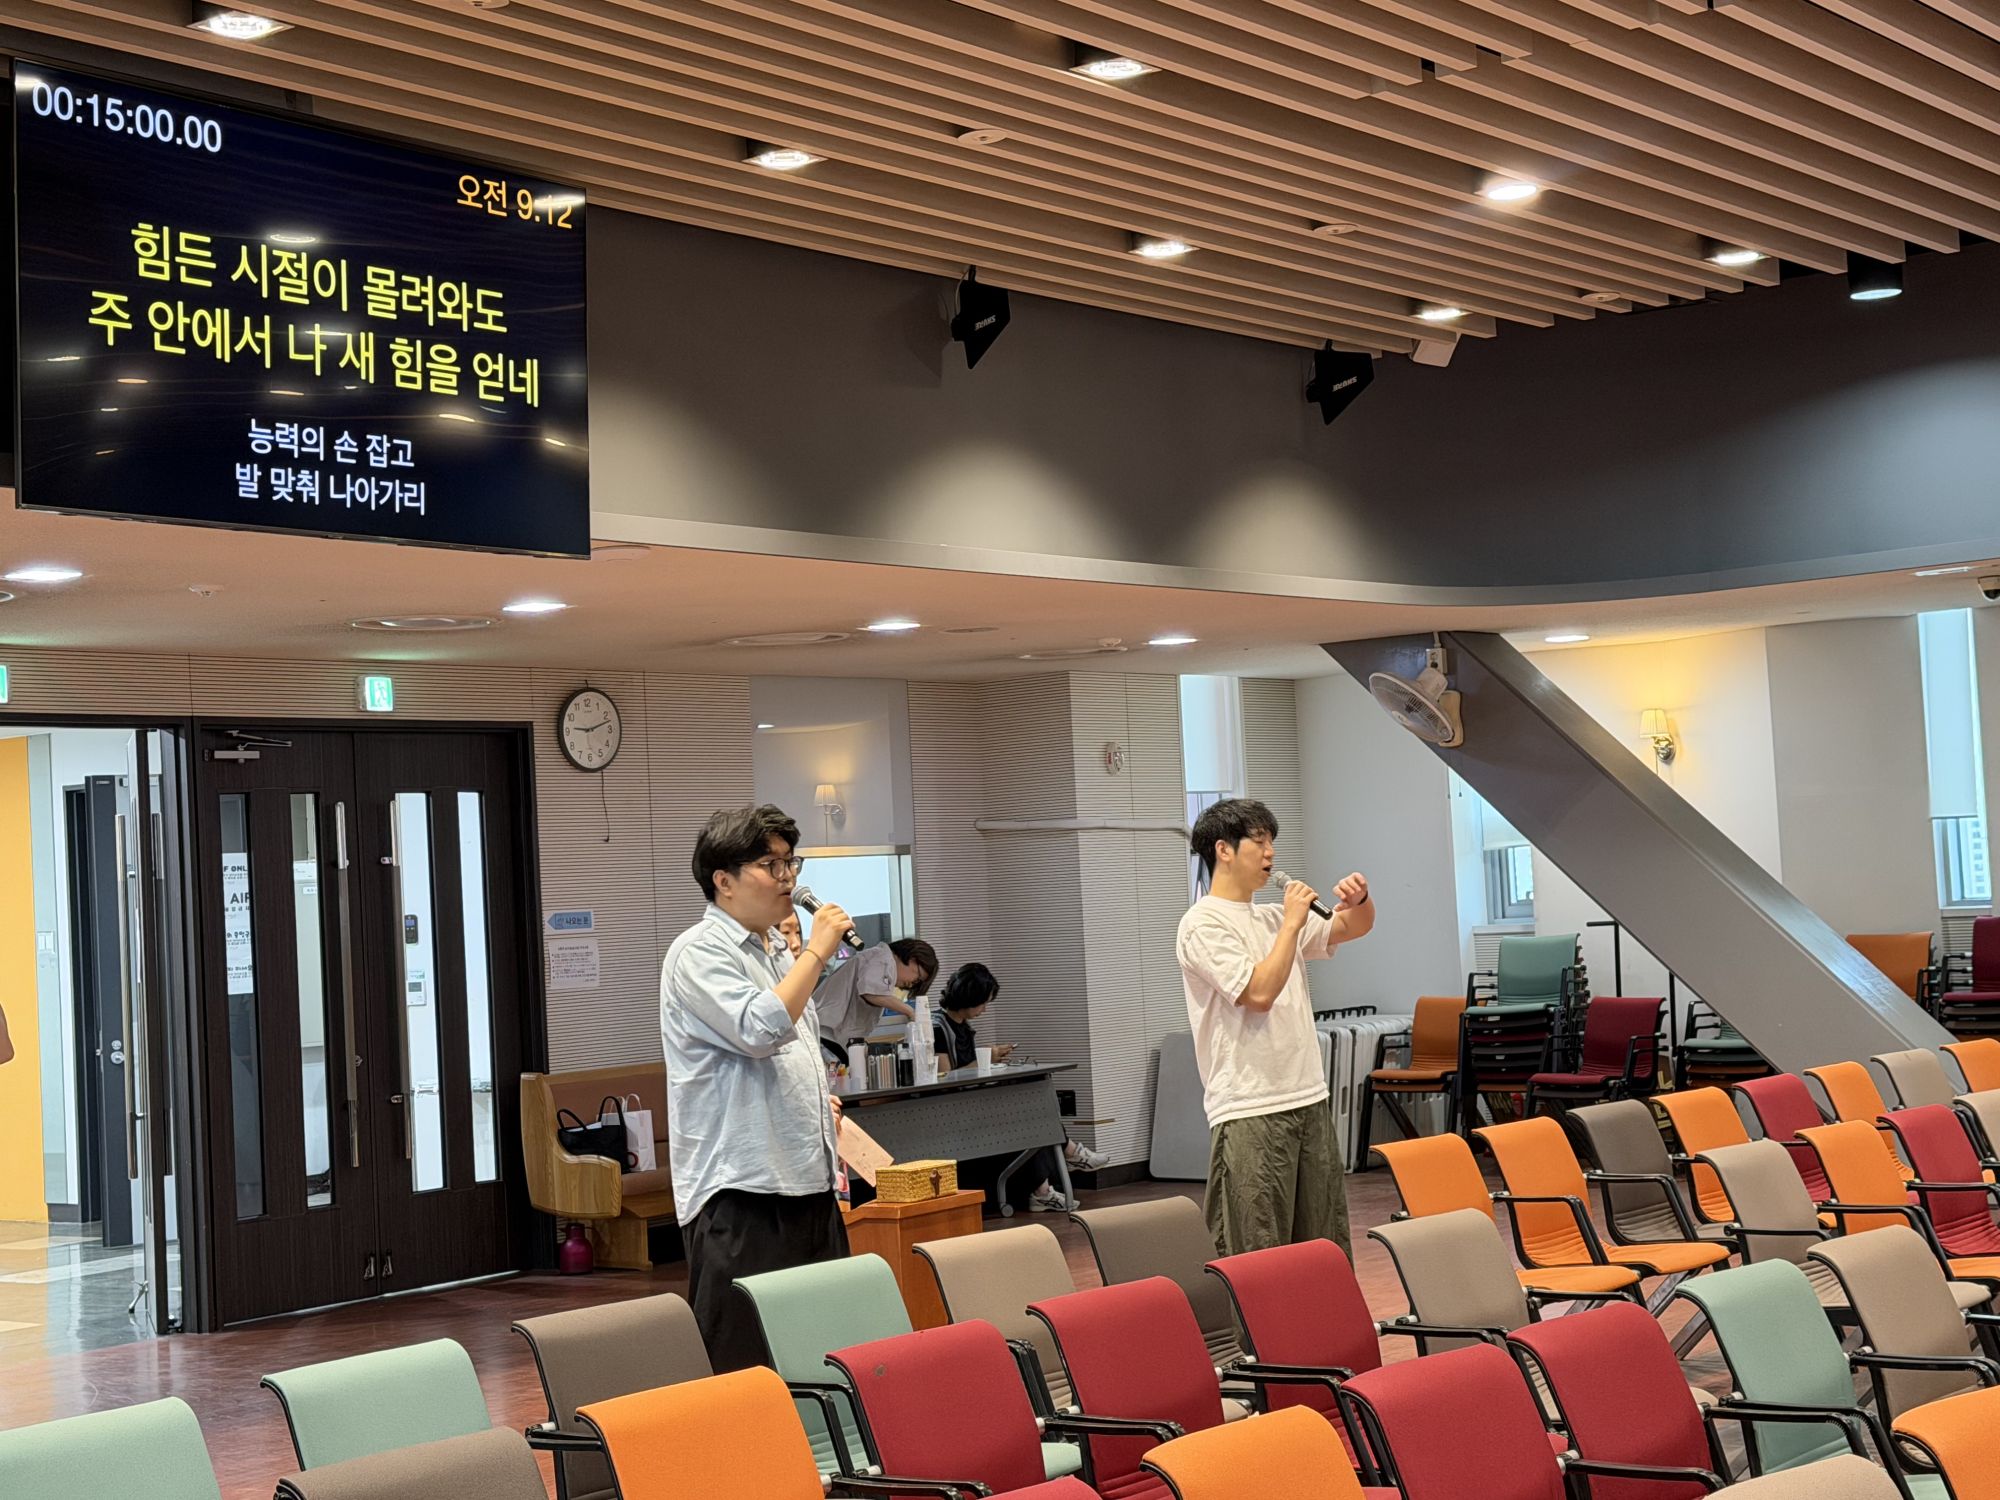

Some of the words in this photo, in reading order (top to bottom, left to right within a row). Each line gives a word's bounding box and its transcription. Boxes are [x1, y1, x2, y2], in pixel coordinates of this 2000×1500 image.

[32, 82, 222, 152] 00:15:00.00
[458, 175, 507, 216] 오전
[131, 222, 216, 288] 힘든
[230, 244, 348, 311] 시절이
[361, 266, 506, 335] 몰려와도
[89, 292, 132, 345] 주
[148, 302, 270, 367] 안에서
[288, 322, 326, 376] 나
[340, 333, 374, 383] 새
[390, 338, 460, 396] 힘을
[473, 353, 539, 407] 얻네
[248, 419, 324, 461] 능력의
[334, 431, 358, 463] 손
[366, 435, 414, 468] 잡고
[236, 463, 261, 498] 발
[271, 468, 319, 505] 맞춰
[330, 474, 424, 515] 나아가리
[574, 703, 580, 711] 11
[583, 698, 591, 707] 12
[596, 702, 599, 710] 1
[567, 713, 575, 722] 10
[603, 712, 608, 720] 2
[565, 727, 570, 736] 9
[608, 725, 612, 733] 3
[570, 742, 575, 751] 8
[605, 740, 609, 748] 4
[578, 751, 582, 759] 7
[588, 754, 592, 762] 6
[598, 749, 603, 758] 5
